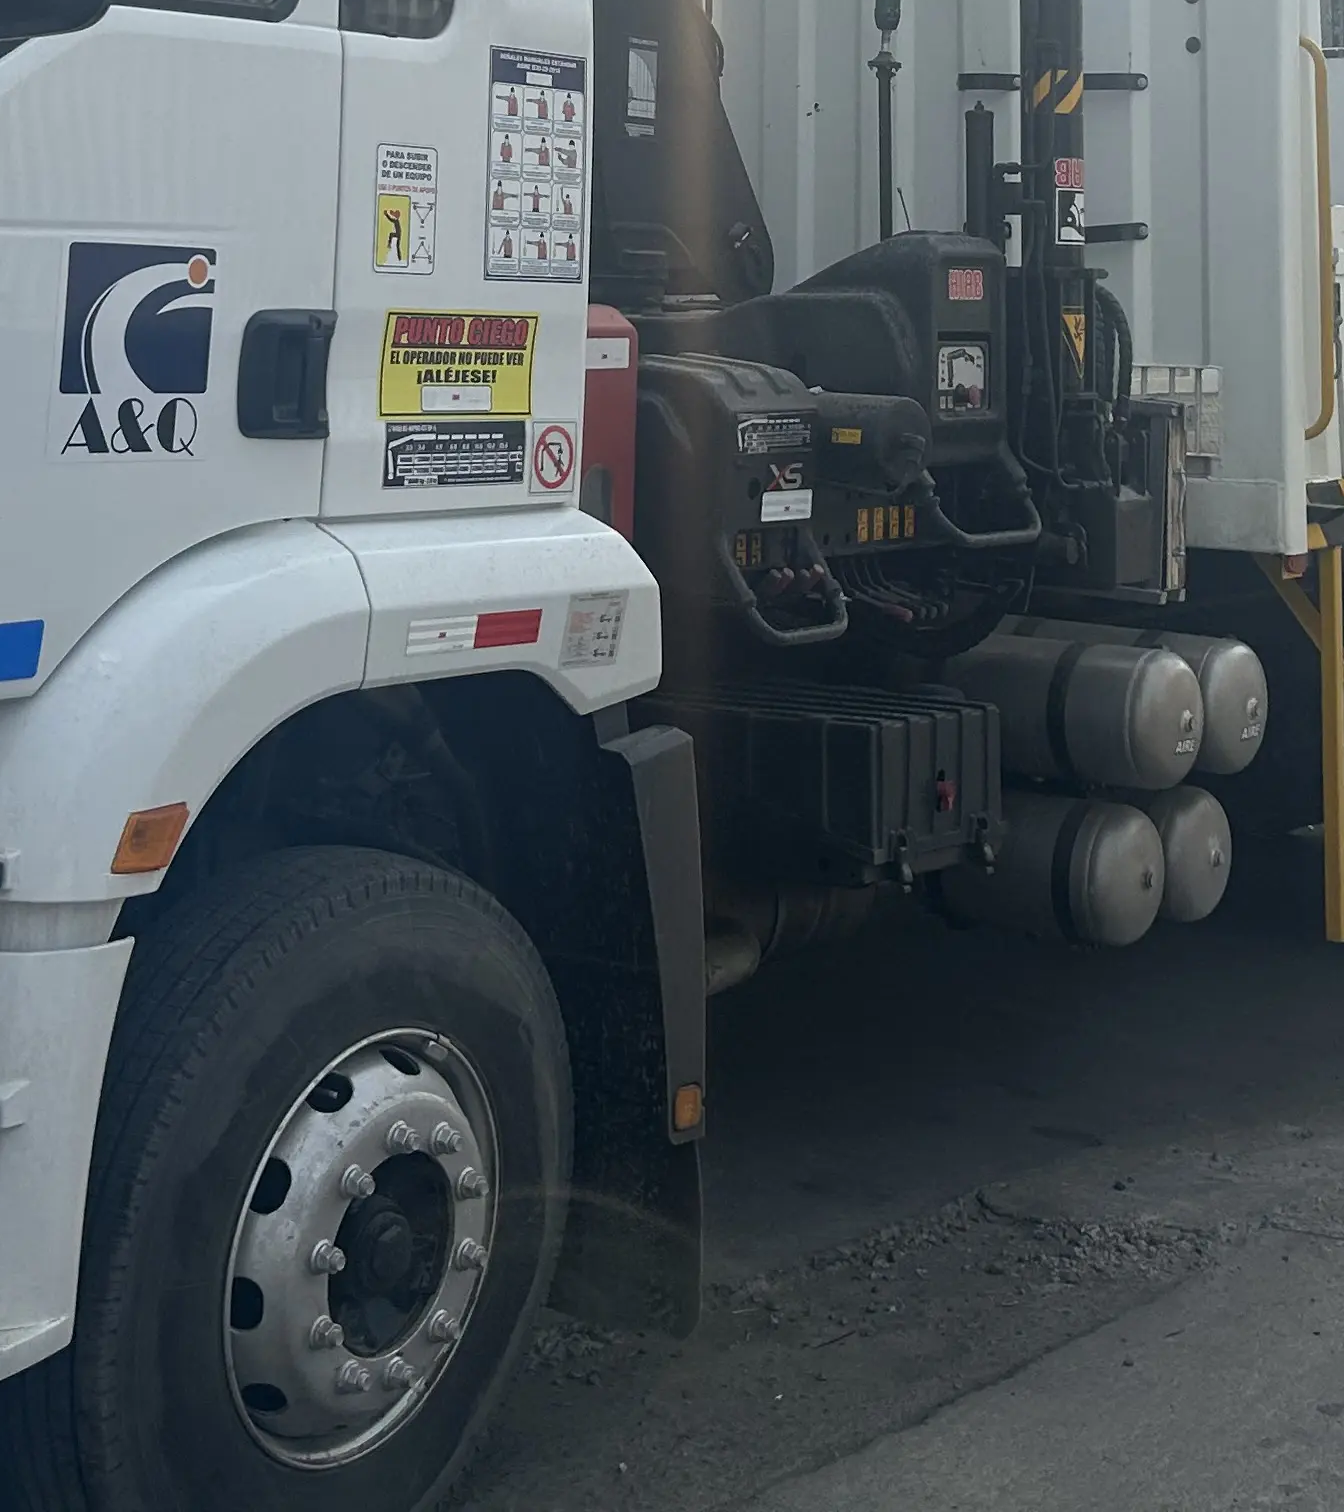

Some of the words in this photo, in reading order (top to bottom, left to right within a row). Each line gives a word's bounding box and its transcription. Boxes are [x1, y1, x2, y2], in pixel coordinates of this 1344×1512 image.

[386, 150, 405, 160] PARA
[382, 160, 388, 168] O
[381, 170, 391, 178] DE
[405, 172, 432, 181] EQUIPO
[394, 316, 465, 345] PUNTO
[468, 318, 529, 346] CIEGO
[390, 351, 401, 364] EL
[403, 351, 456, 365] OPERADOR
[458, 352, 471, 365] NO
[474, 353, 504, 365] PUEDE
[506, 353, 524, 366] VER
[416, 367, 497, 384] ¡ALÉJESE!
[61, 397, 198, 456] A&Q
[1240, 724, 1261, 740] AIRE
